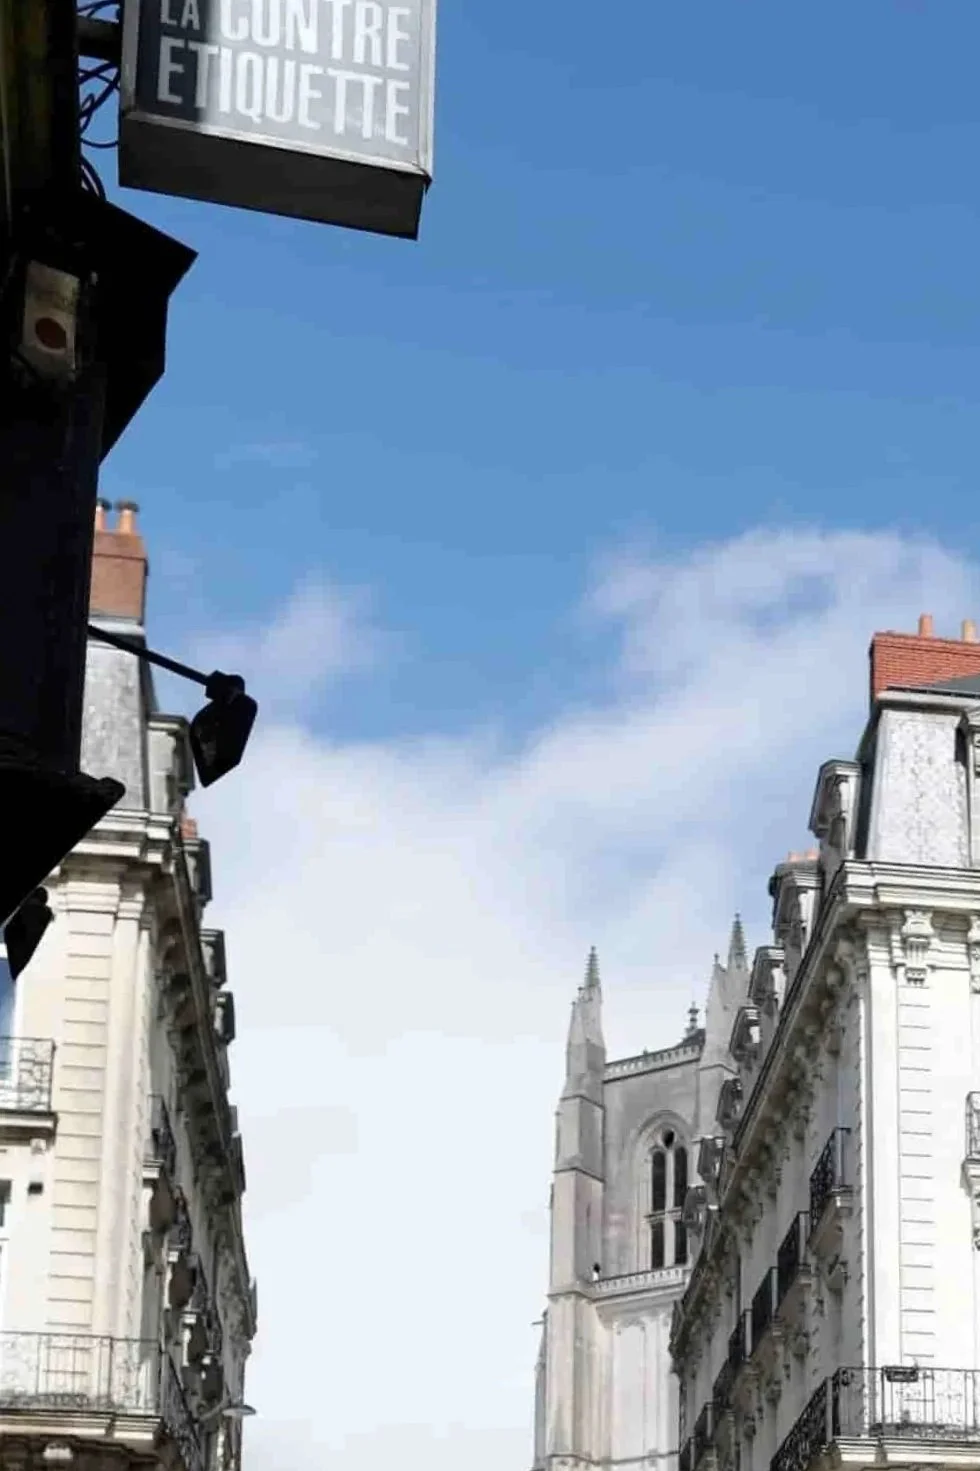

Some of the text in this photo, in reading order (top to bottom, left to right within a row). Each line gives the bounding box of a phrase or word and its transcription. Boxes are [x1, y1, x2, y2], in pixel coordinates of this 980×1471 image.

[161, 0, 411, 71] LA CONTRE
[159, 36, 410, 144] ETIQUETTE
